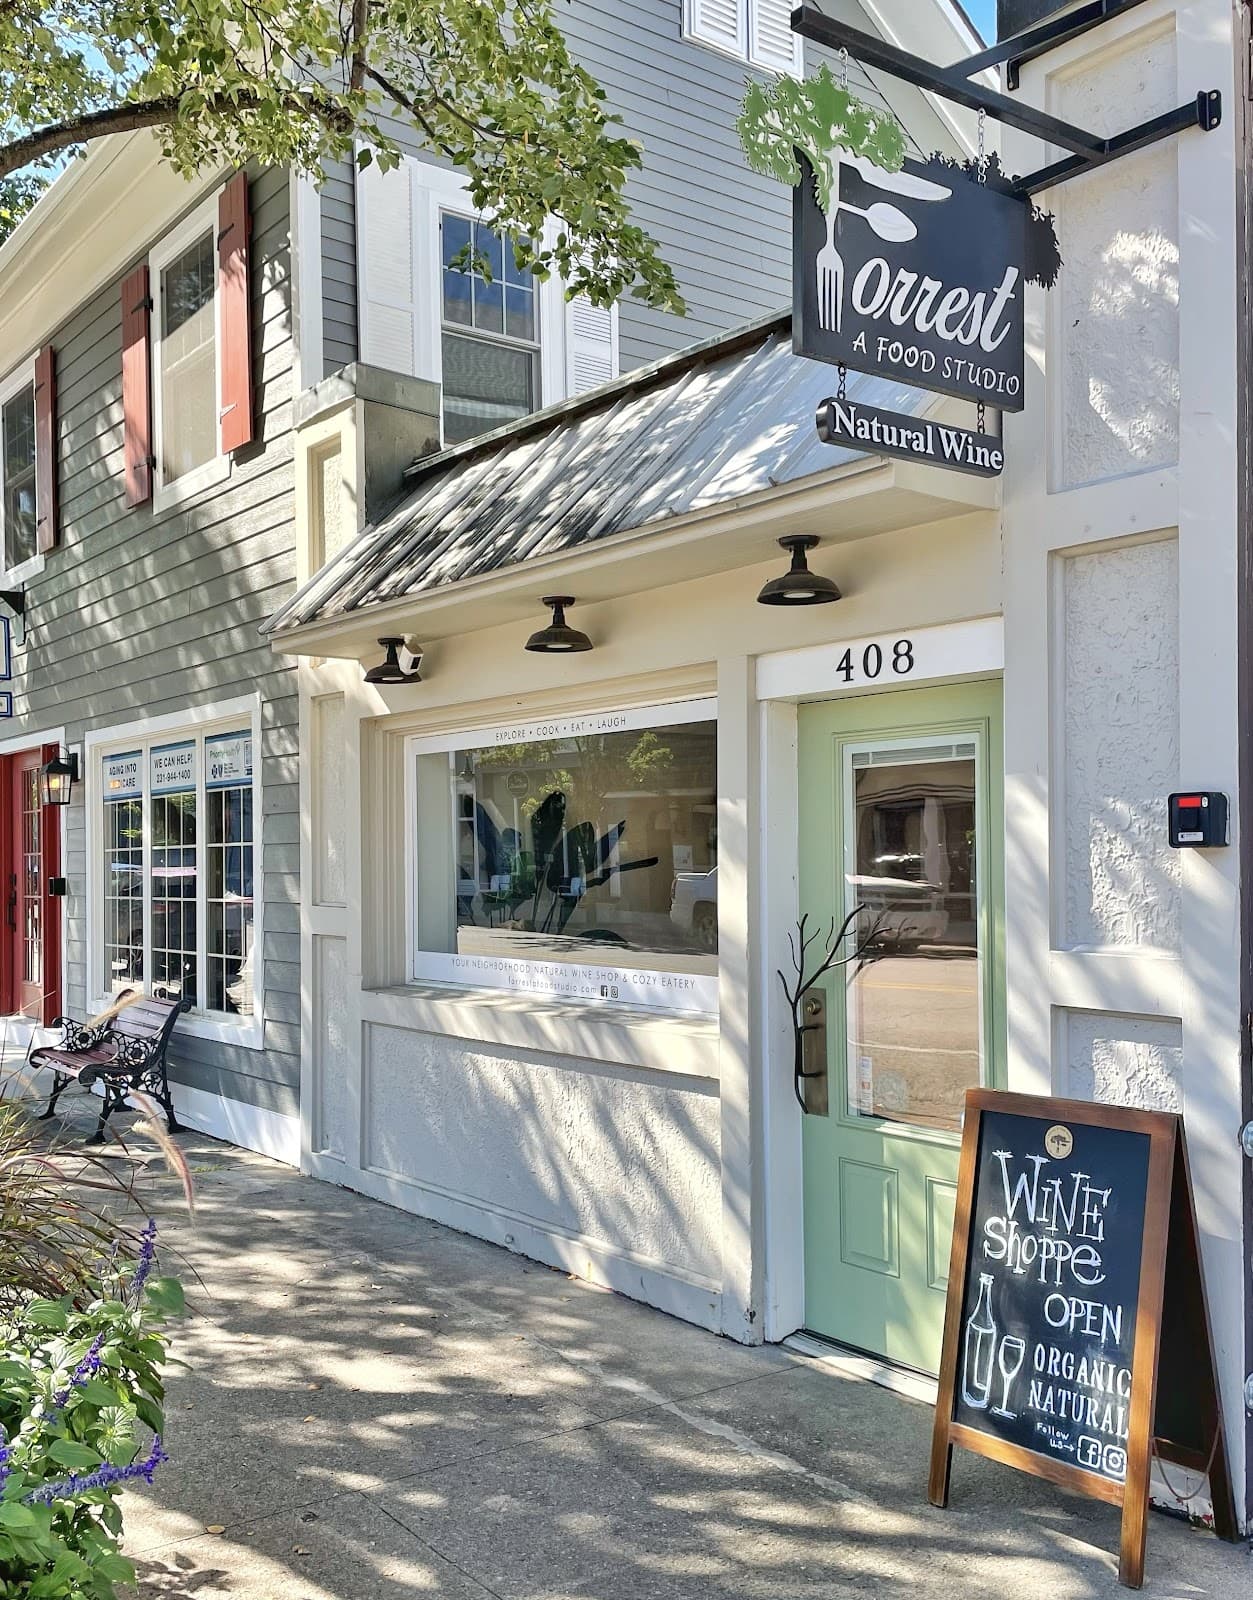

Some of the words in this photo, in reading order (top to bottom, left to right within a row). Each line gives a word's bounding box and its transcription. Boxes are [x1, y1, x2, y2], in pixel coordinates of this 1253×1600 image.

[852, 336, 868, 354] A
[876, 338, 936, 373] FOOD
[941, 357, 1020, 396] STUDIO
[831, 402, 935, 456] Natural
[939, 429, 1004, 471] Wine
[836, 639, 914, 682] 408
[495, 729, 526, 742] EXPLORE
[536, 725, 560, 737] COOK
[571, 721, 585, 732] EAT
[597, 716, 626, 729] LAUGH
[108, 765, 124, 776] AGING
[124, 762, 137, 774] INTO
[153, 758, 162, 769] WE
[164, 756, 176, 767] CAN
[176, 753, 193, 766] HELP!
[451, 958, 470, 967] YOUR
[534, 966, 568, 977] NATURAL
[571, 968, 592, 980] WINE
[596, 971, 619, 982] SHOP
[622, 975, 628, 983] &
[632, 974, 657, 985] COZY
[661, 977, 695, 990] EATERY
[1044, 1292, 1122, 1345] OPEN
[1034, 1343, 1132, 1398] ORGANIC
[1028, 1379, 1129, 1440] NATURAL
[1036, 1422, 1070, 1440] Follow
